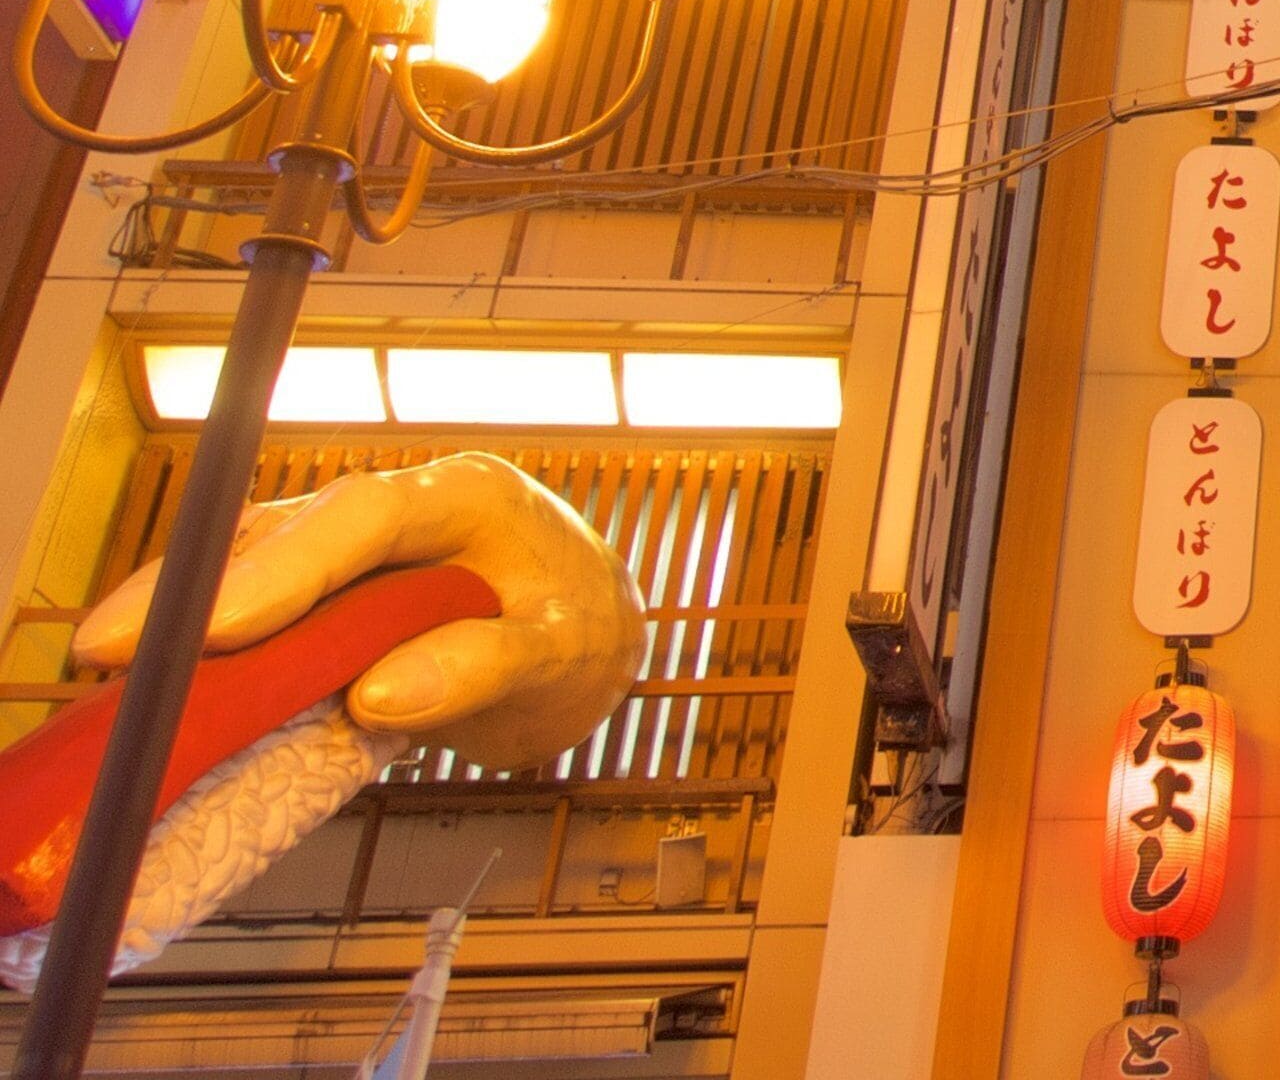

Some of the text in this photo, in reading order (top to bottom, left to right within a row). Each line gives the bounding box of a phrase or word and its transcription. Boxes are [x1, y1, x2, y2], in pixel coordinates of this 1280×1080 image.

[1200, 167, 1248, 335] たよし
[1176, 420, 1219, 609] とんぼり
[1129, 696, 1204, 915] たよし
